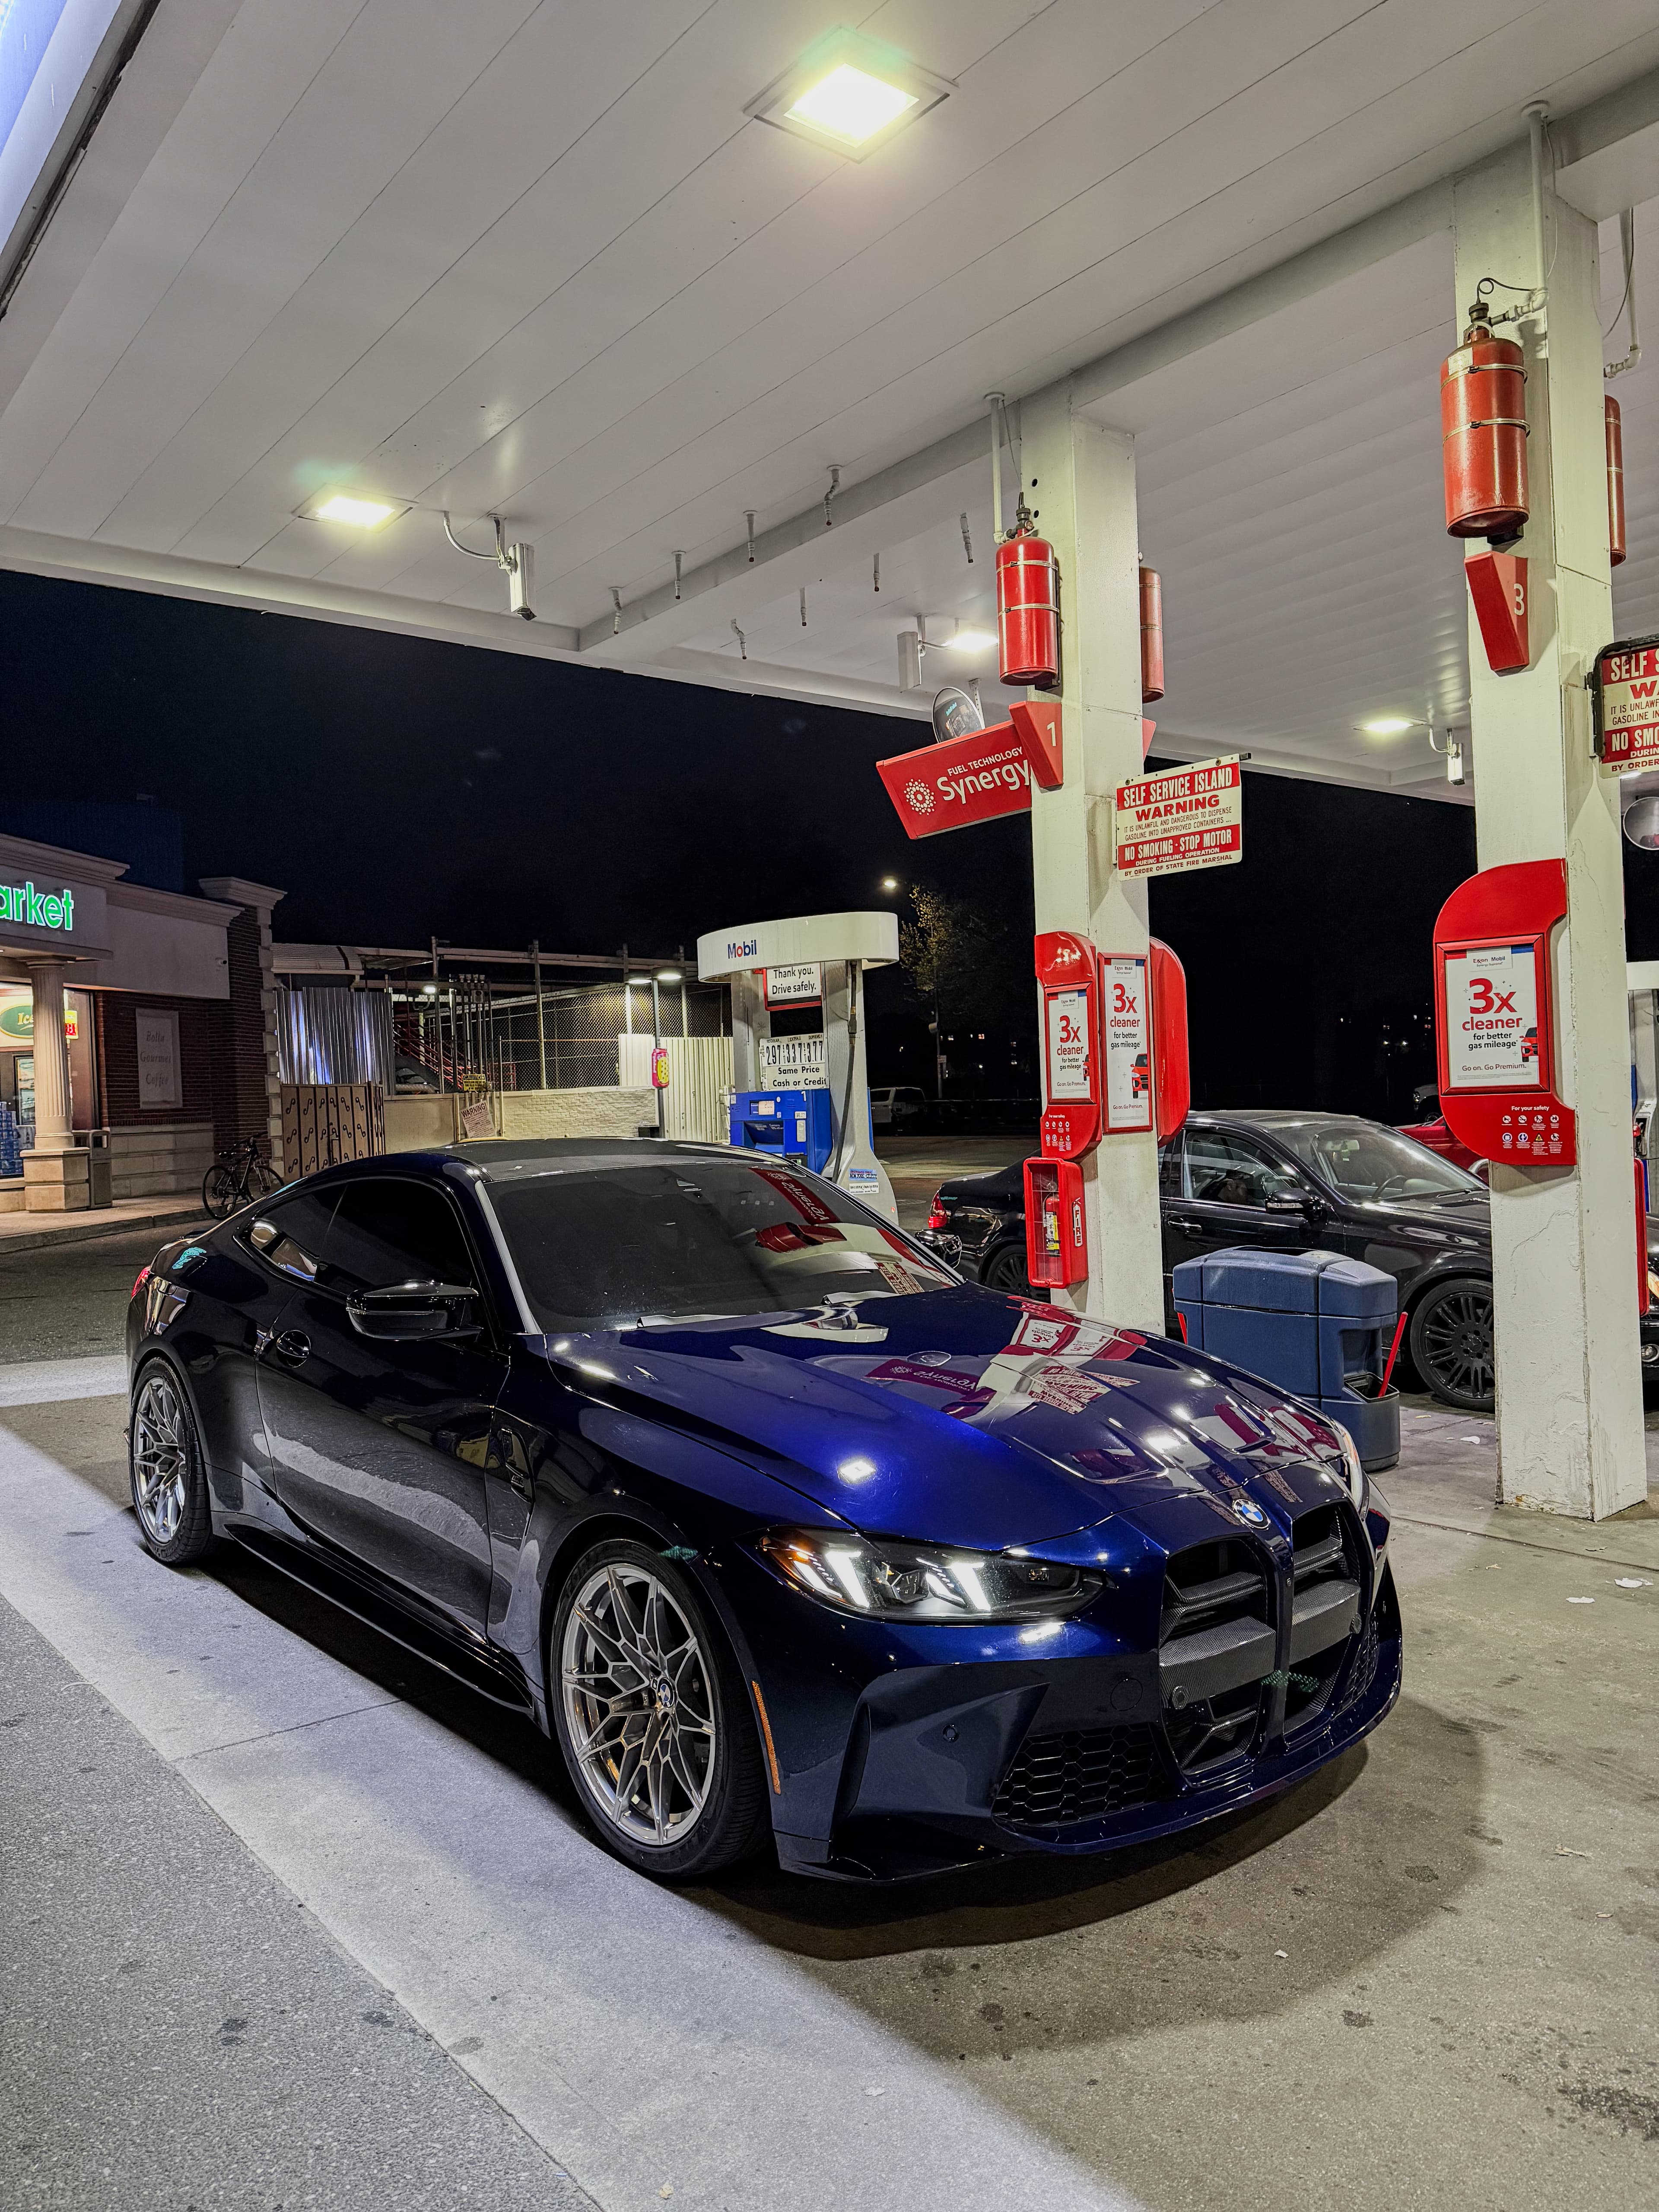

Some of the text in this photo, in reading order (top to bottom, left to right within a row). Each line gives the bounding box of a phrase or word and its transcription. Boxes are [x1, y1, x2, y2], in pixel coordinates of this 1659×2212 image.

[1513, 583, 1524, 616] 3
[1611, 651, 1647, 681] SELF
[1611, 706, 1617, 715] IT
[1620, 705, 1627, 713] IS
[1612, 712, 1649, 725] GASOLINE
[1047, 721, 1056, 747] 1
[1611, 731, 1628, 751] NO
[947, 747, 1023, 776] FUEL TECHNOLOGY
[937, 760, 1030, 804] Synergy
[1124, 767, 1232, 807] SELF SERVICE ISLAND
[1135, 795, 1220, 822] WARNING
[1135, 821, 1159, 831] UNLAWFUL
[1171, 814, 1199, 824] DANGEROUS
[1208, 806, 1232, 817] DISPENSE
[1125, 832, 1147, 841] GASOLINE
[1161, 823, 1191, 834] UNAPPROVED
[1194, 817, 1224, 828] CONTAINERS
[1125, 829, 1232, 861] NO SMOKING STOP MOTOR
[1134, 867, 1153, 875] ORDER
[1202, 855, 1233, 864] MARSHAL
[1135, 847, 1220, 866] DURING FUELING OPERATION
[728, 939, 757, 959] Mobil
[773, 966, 814, 979] Thank you.
[772, 980, 817, 995] Drive safely.
[1469, 978, 1517, 1014] 3x
[1113, 983, 1138, 1014] 3x
[1059, 1015, 1081, 1043] 3x
[1110, 1016, 1140, 1027] cleaner
[1462, 1017, 1523, 1031] cleaner
[1057, 1045, 1084, 1055] cleaner
[1468, 1042, 1482, 1051] gas
[801, 1065, 820, 1073] Price
[773, 1078, 790, 1087] Cash
[804, 1077, 826, 1085] Credit
[801, 1090, 806, 1101] 1
[461, 1102, 487, 1118] WARNING!
